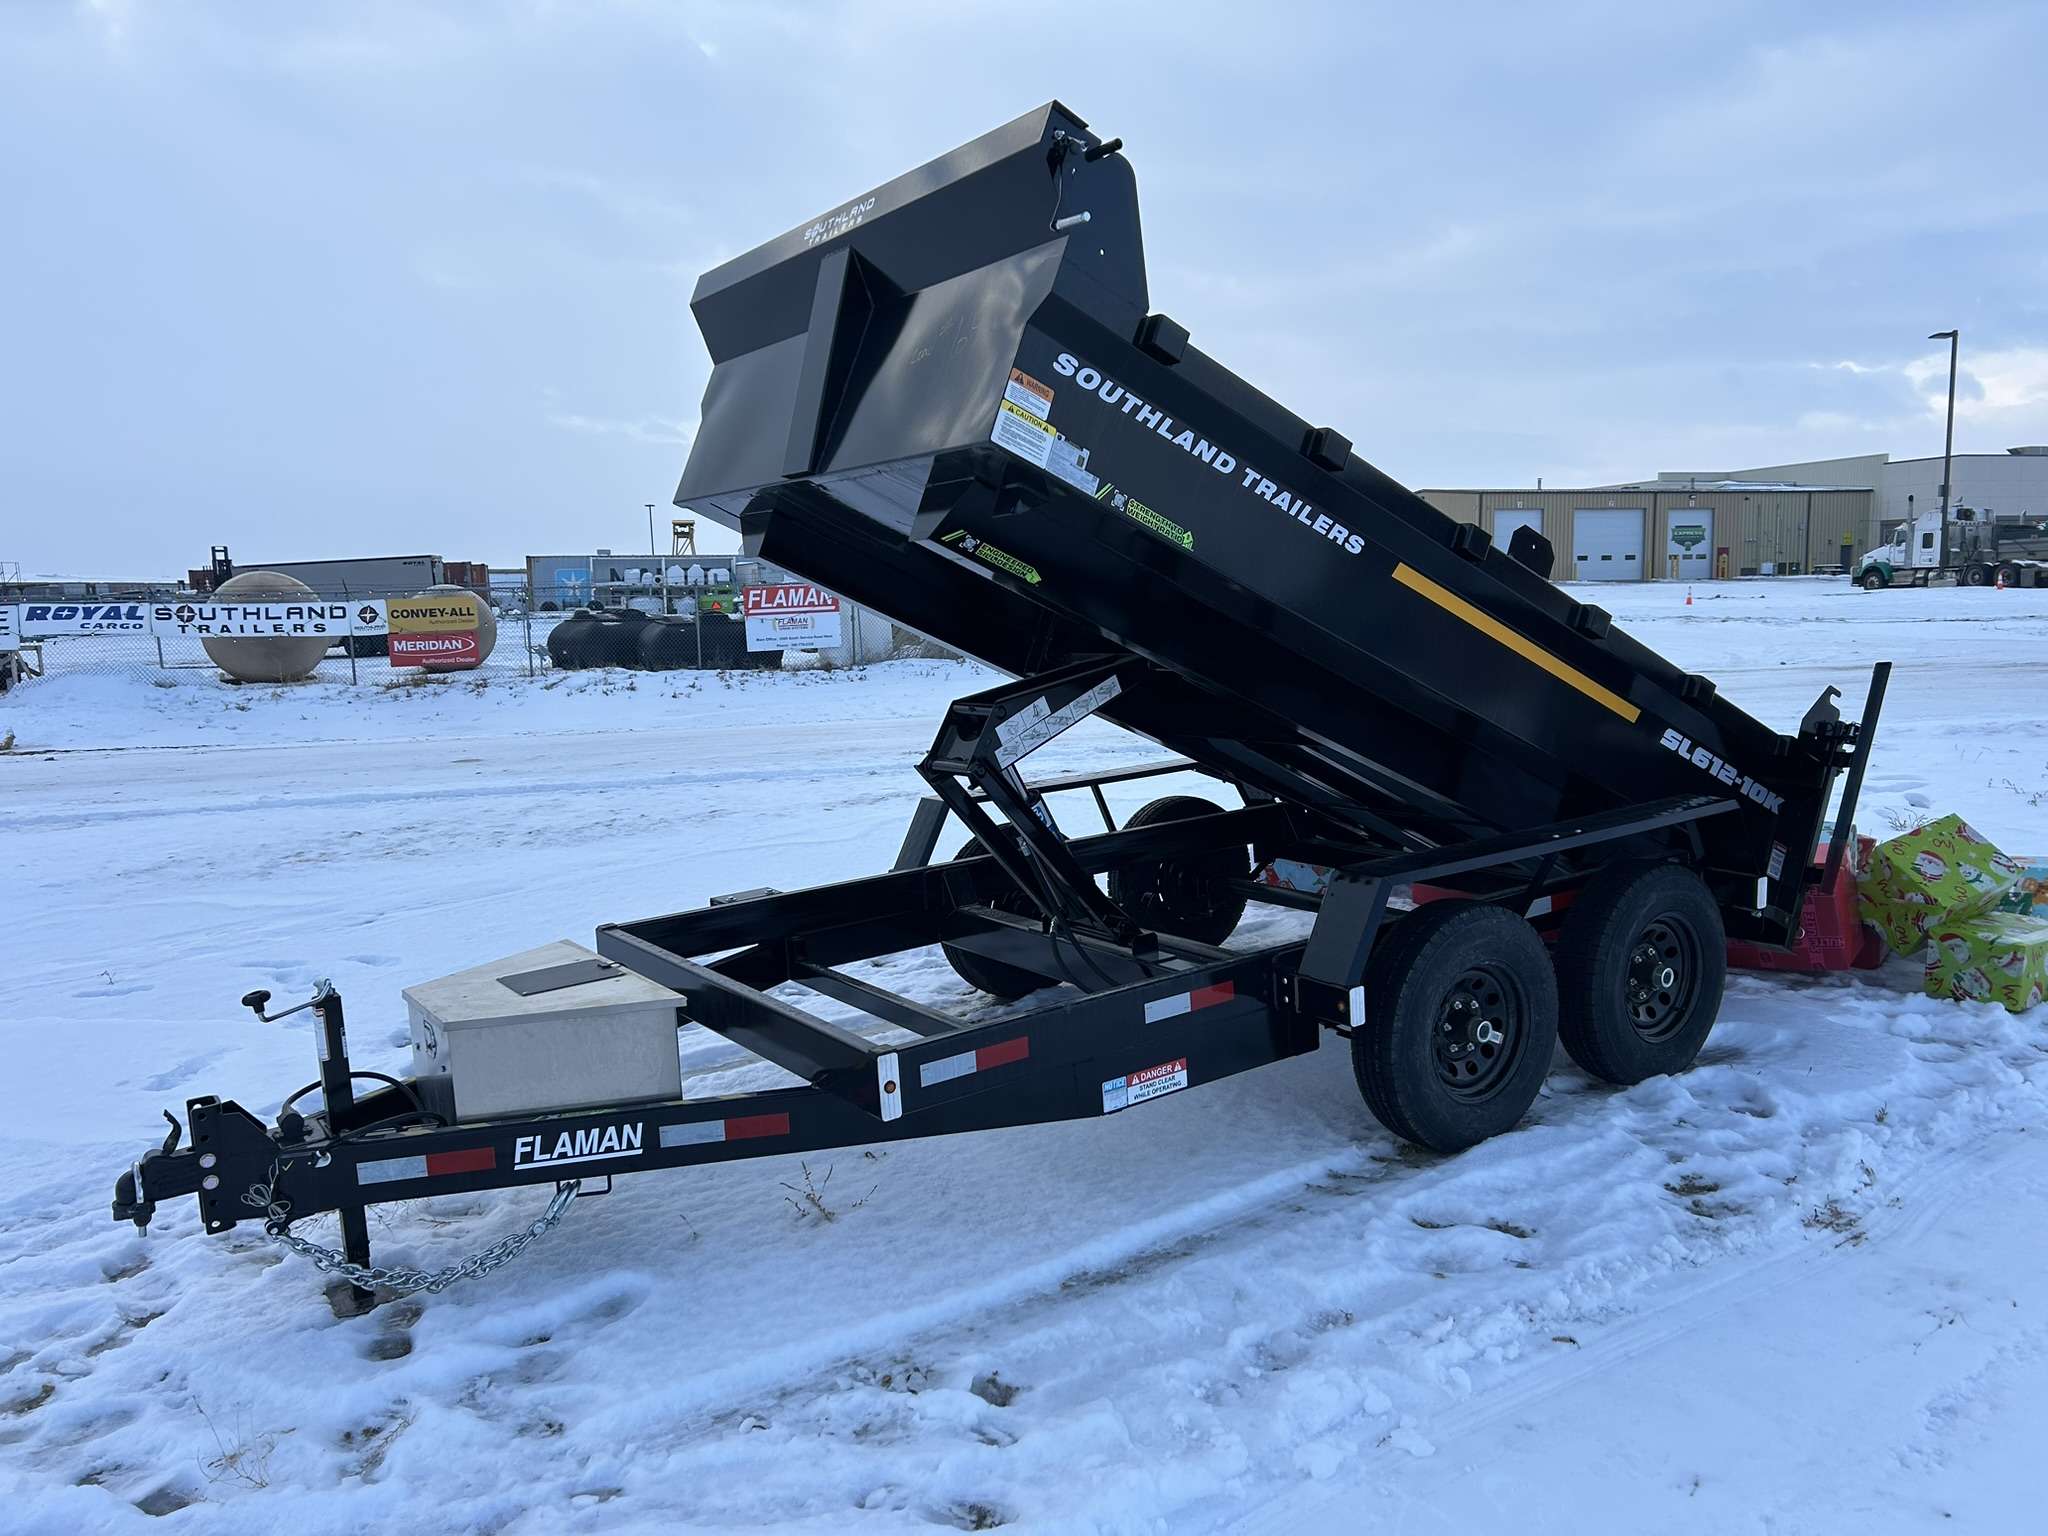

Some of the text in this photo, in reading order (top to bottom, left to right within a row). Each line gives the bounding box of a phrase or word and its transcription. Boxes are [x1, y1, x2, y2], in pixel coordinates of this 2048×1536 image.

[804, 197, 875, 240] SOUTHLAND
[808, 215, 863, 246] TRAILERS
[1015, 409, 1042, 429] CAUTION
[1053, 353, 1237, 474] SOUTHLAND
[1241, 467, 1365, 554] TRAILERS
[1129, 500, 1172, 528] STRENGTH
[1128, 507, 1184, 543] WEIGHT RATIO
[982, 545, 1034, 573] ENGINEERED
[748, 587, 833, 609] FLAMAN
[25, 606, 145, 621] ROYAL
[155, 605, 346, 623] SOUTHLAND
[390, 607, 475, 619] CONVEY-ALL
[777, 617, 809, 625] FLAMAN
[80, 622, 143, 630] CARGO
[178, 624, 327, 634] TRAILERS
[393, 640, 462, 652] MERIDIAN
[1660, 728, 1785, 814] SL612-10K
[1140, 1064, 1173, 1081] DANGER
[1104, 1079, 1126, 1090] NOTICE
[1140, 1074, 1176, 1091] STAND CLEAR
[1133, 1090, 1150, 1100] WHILE
[514, 1122, 643, 1163] FLAMAN
